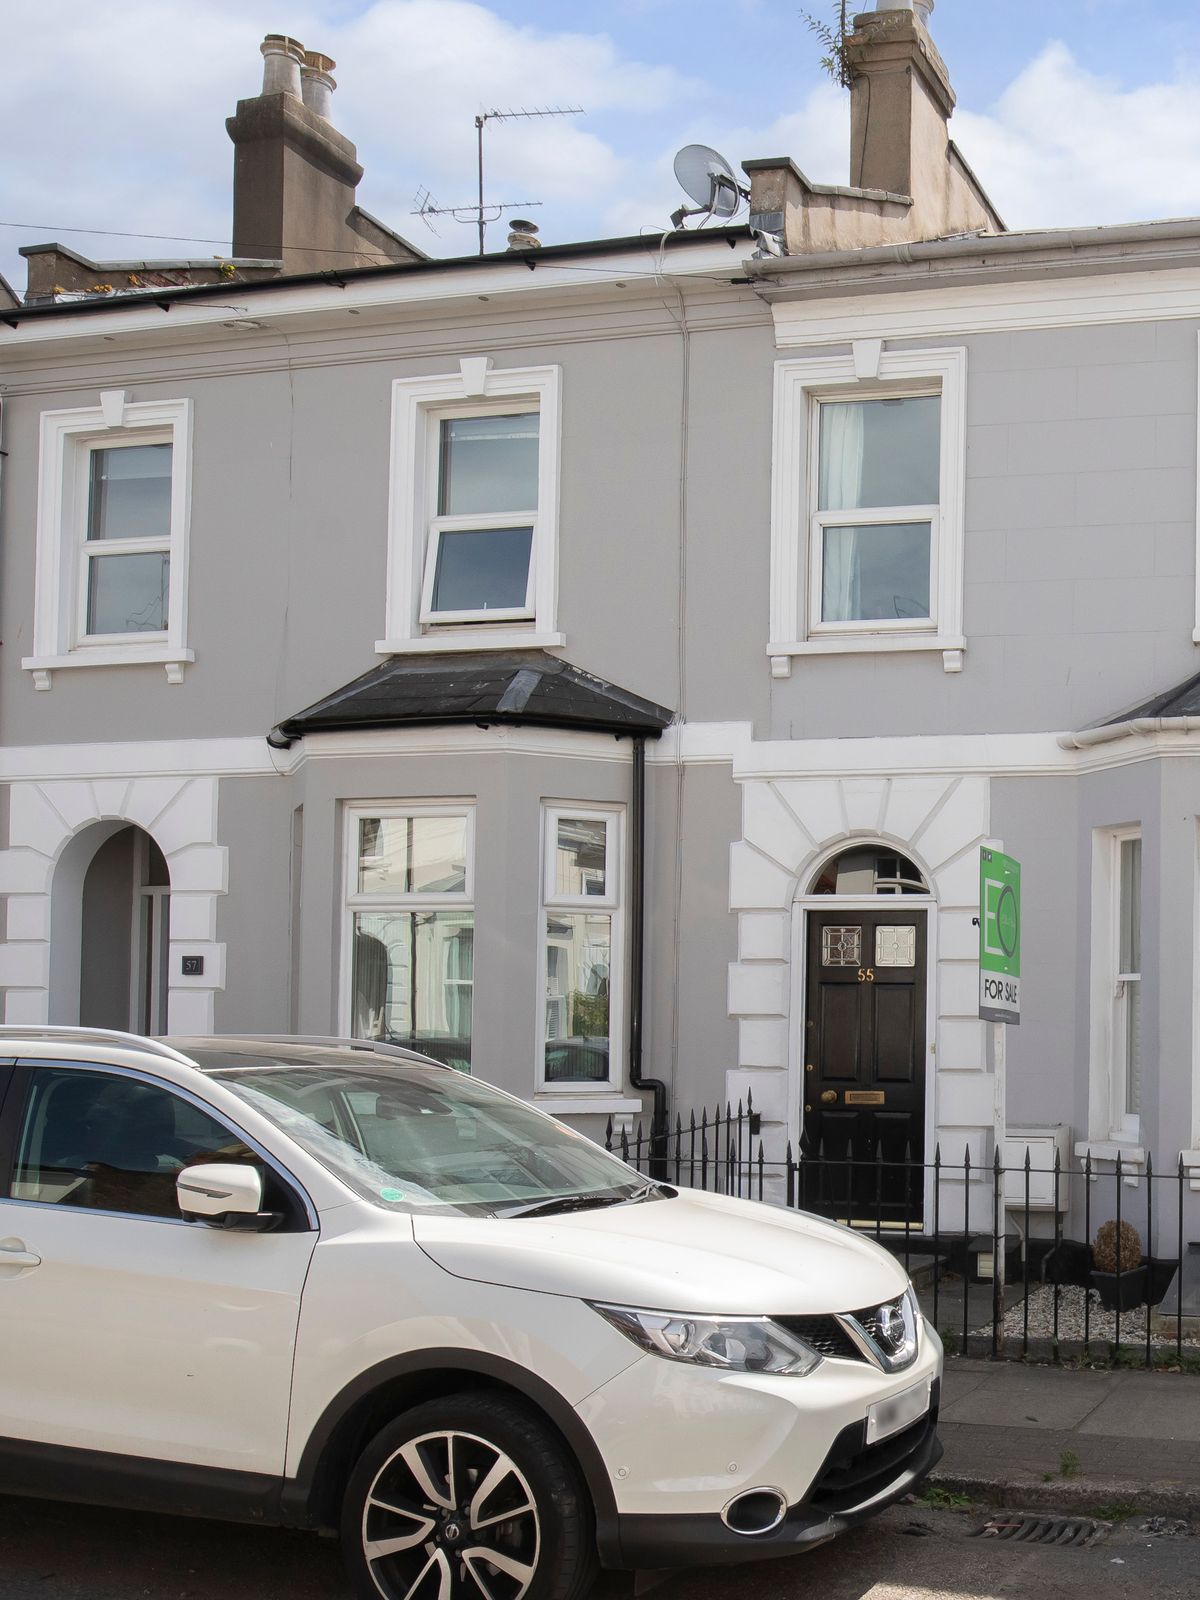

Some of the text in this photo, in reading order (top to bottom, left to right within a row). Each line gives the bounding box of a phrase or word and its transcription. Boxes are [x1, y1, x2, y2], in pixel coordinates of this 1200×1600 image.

[185, 960, 197, 970] 57
[857, 968, 874, 981] 55
[984, 978, 1017, 1004] FOR SALE
